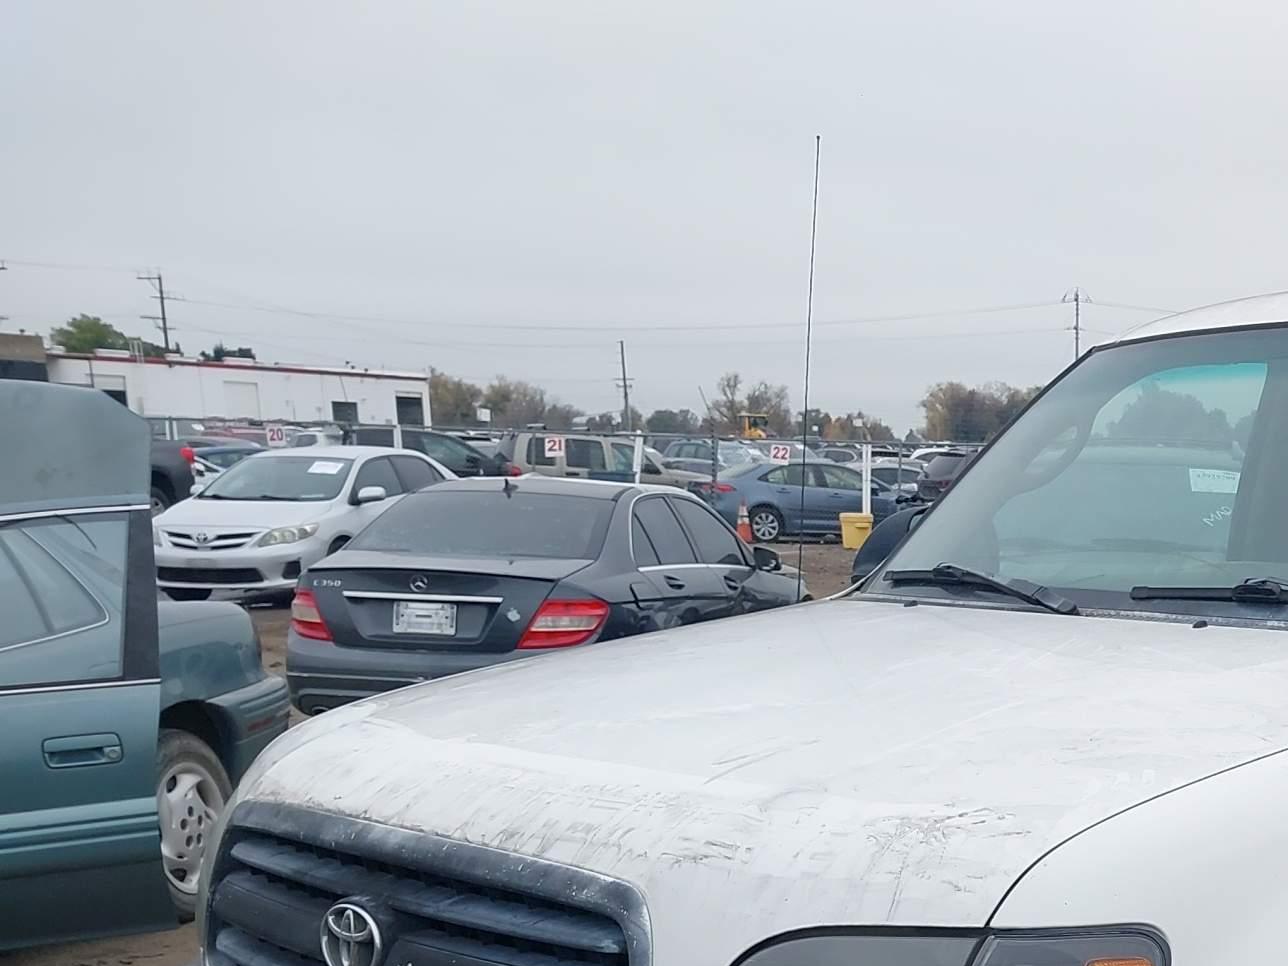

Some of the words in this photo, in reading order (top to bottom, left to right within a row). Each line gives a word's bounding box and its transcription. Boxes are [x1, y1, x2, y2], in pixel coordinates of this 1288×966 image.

[268, 428, 284, 441] 20
[547, 438, 562, 452] 21
[772, 446, 789, 460] 22
[321, 579, 342, 588] 350
